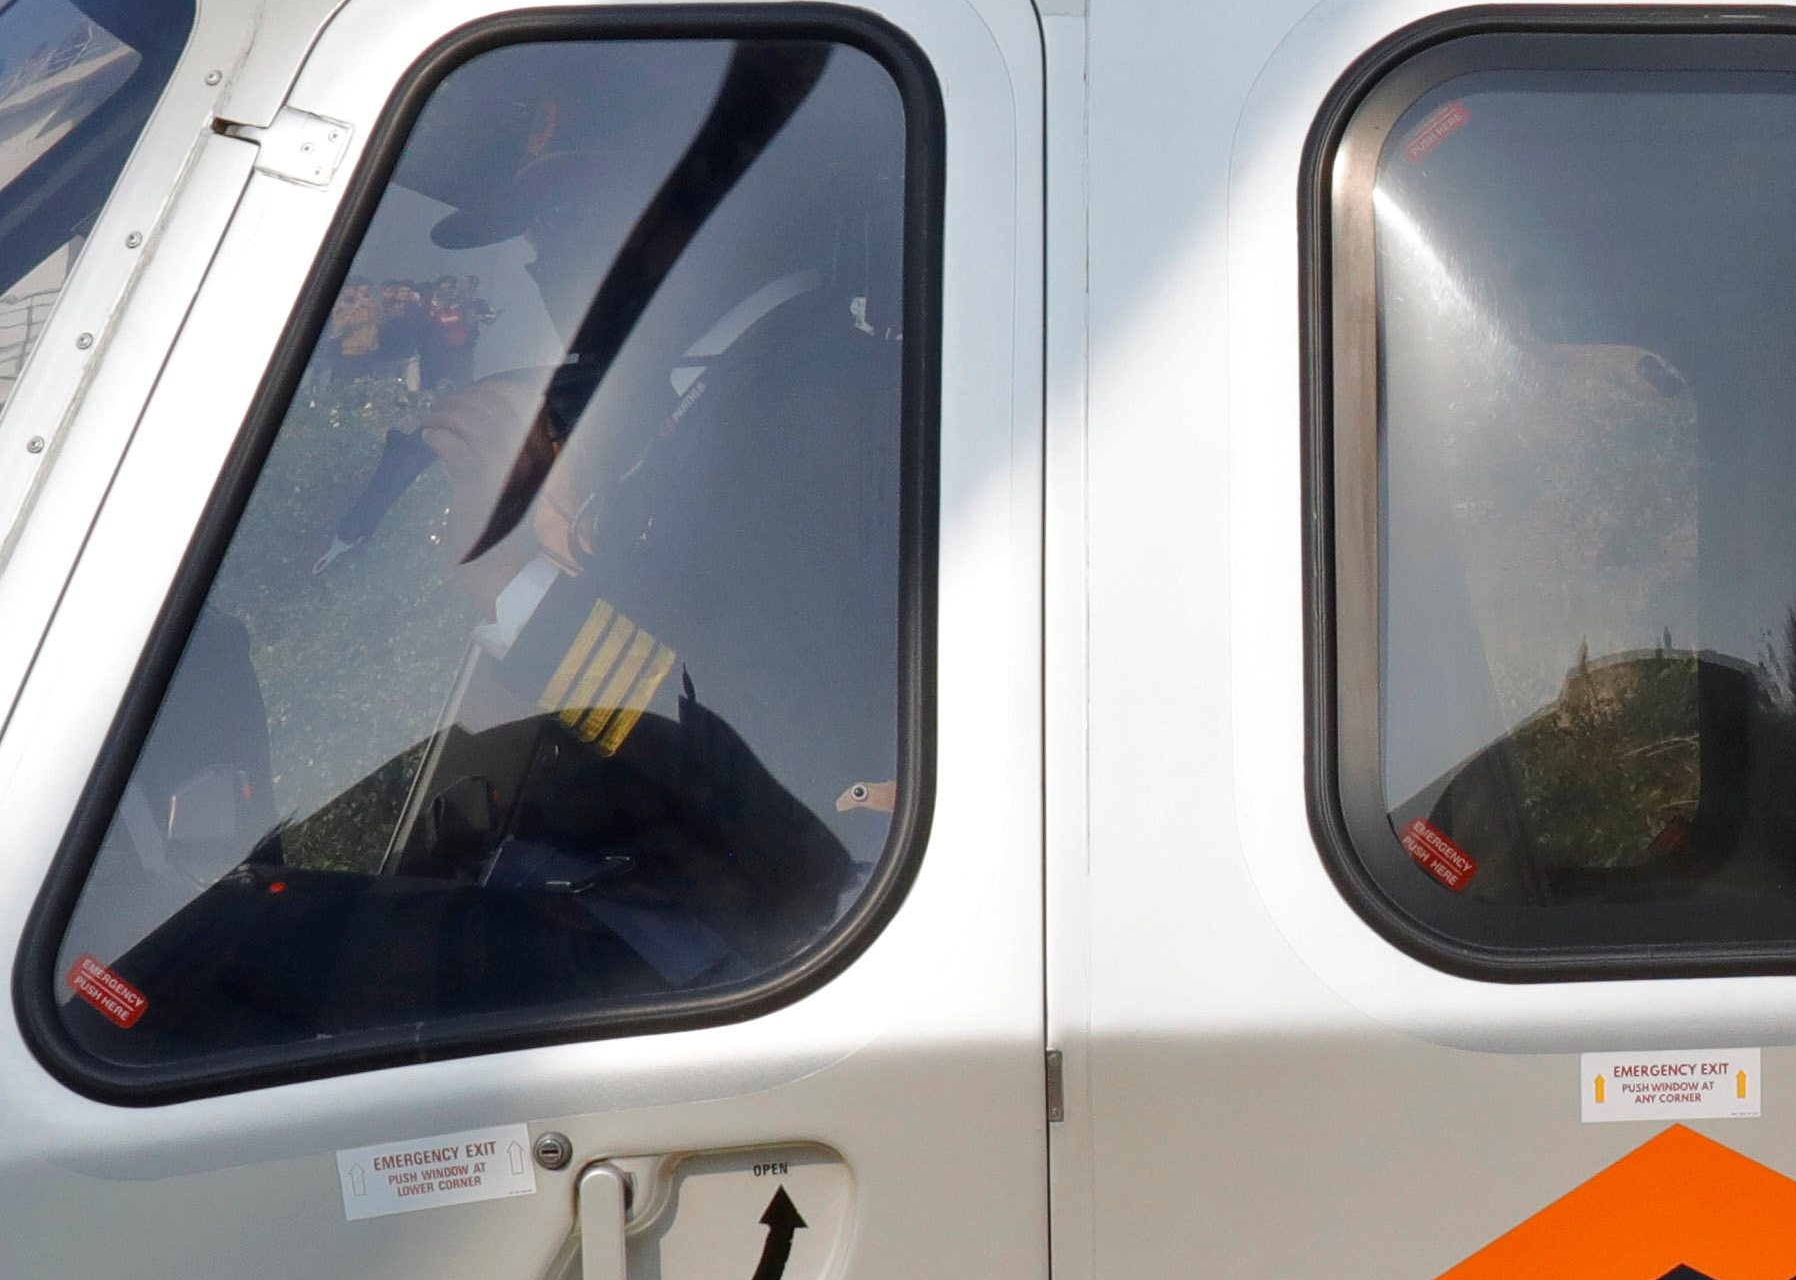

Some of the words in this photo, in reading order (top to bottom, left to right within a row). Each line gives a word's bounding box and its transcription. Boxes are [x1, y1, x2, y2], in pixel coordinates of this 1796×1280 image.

[1413, 821, 1473, 872] EMERGENCY
[1402, 836, 1431, 862] PUSH
[1430, 859, 1459, 886] HERE
[82, 958, 144, 1008] EMERGENCY
[73, 975, 103, 1001] PUSH
[100, 995, 130, 1022] HERE
[1613, 1063, 1698, 1078] EMERGENCY
[1701, 1062, 1730, 1076] EXIT
[1622, 1082, 1649, 1093] PUSH
[1651, 1081, 1699, 1092] WINDOW
[1701, 1081, 1715, 1091] AT
[1634, 1094, 1657, 1105] ANY
[1659, 1092, 1702, 1104] CORNER
[373, 1145, 460, 1172] EMERGENCY
[466, 1141, 497, 1158] EXIT
[388, 1171, 418, 1186] PUSH
[421, 1164, 470, 1182] WINDOW
[473, 1161, 487, 1174] AT
[753, 1162, 789, 1178] OPEN
[397, 1182, 435, 1198] LOWER
[438, 1176, 483, 1192] CORNER
